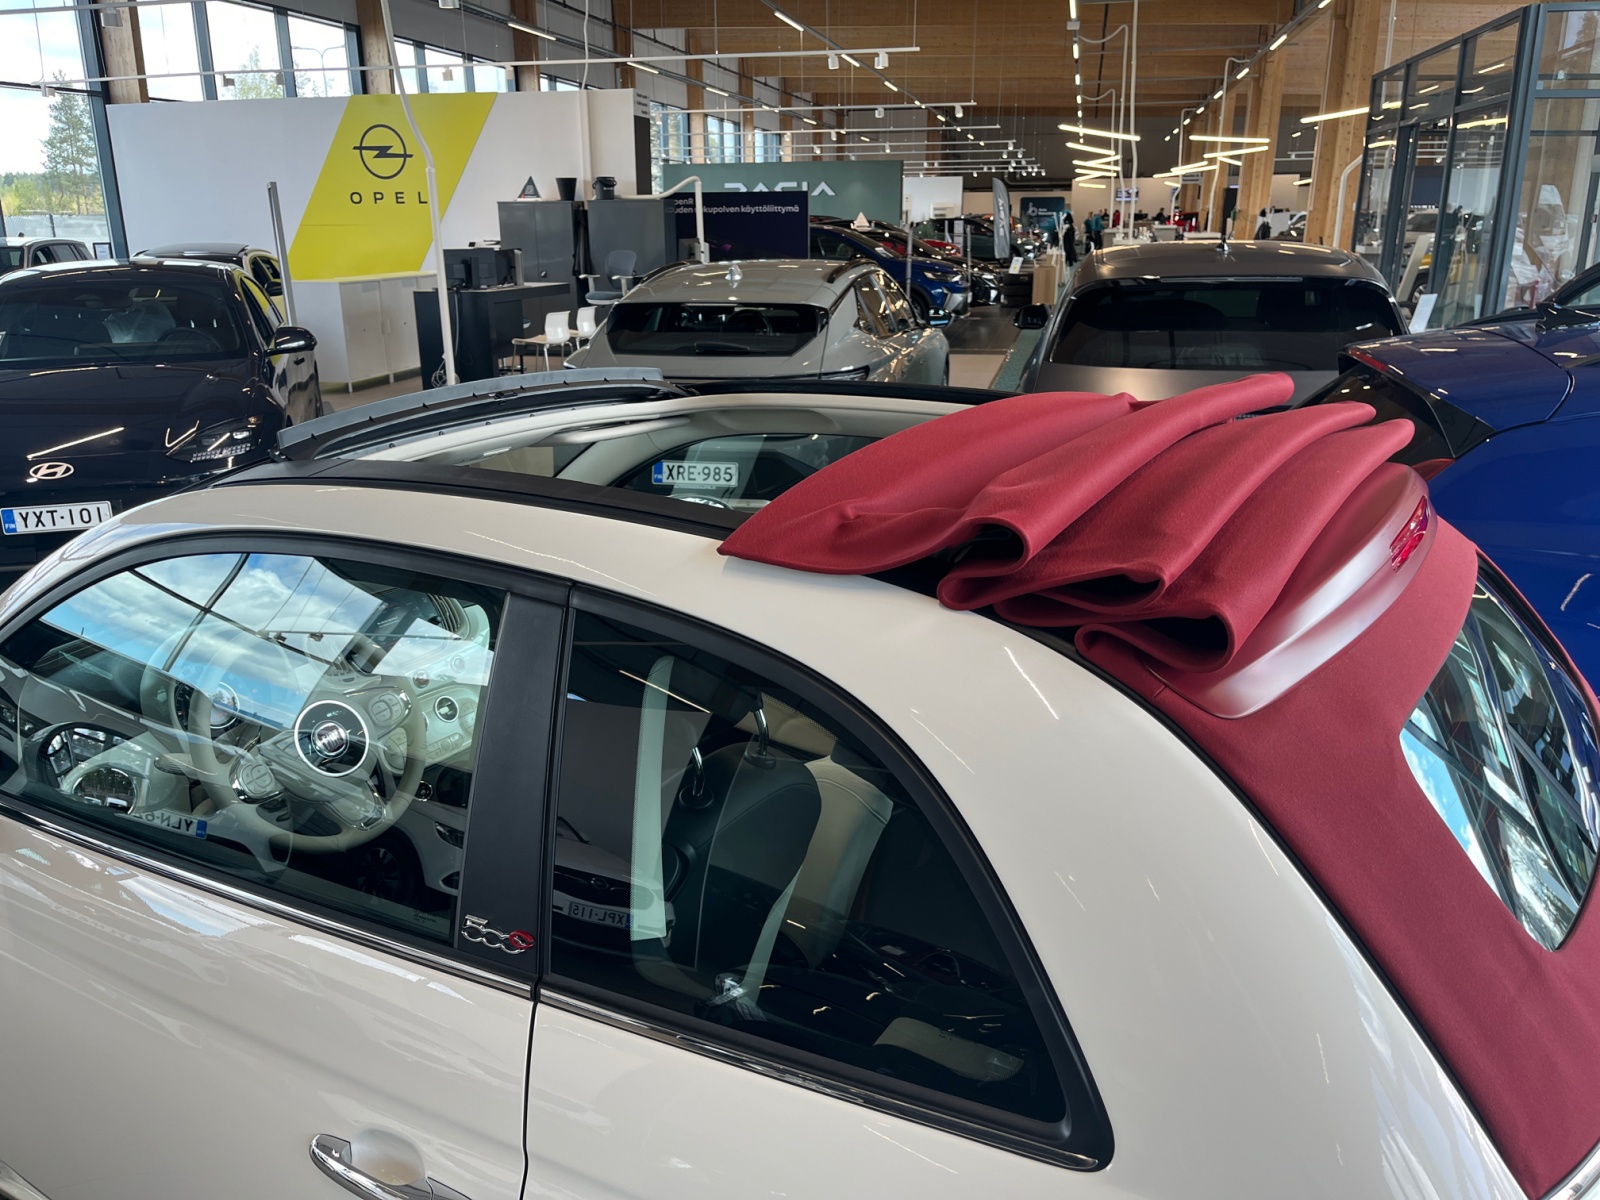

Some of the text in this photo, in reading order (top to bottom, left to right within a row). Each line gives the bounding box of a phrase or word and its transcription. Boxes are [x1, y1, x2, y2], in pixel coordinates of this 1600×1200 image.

[350, 191, 428, 204] OPEL
[666, 464, 733, 482] XRE-985
[19, 506, 102, 529] YXT-101
